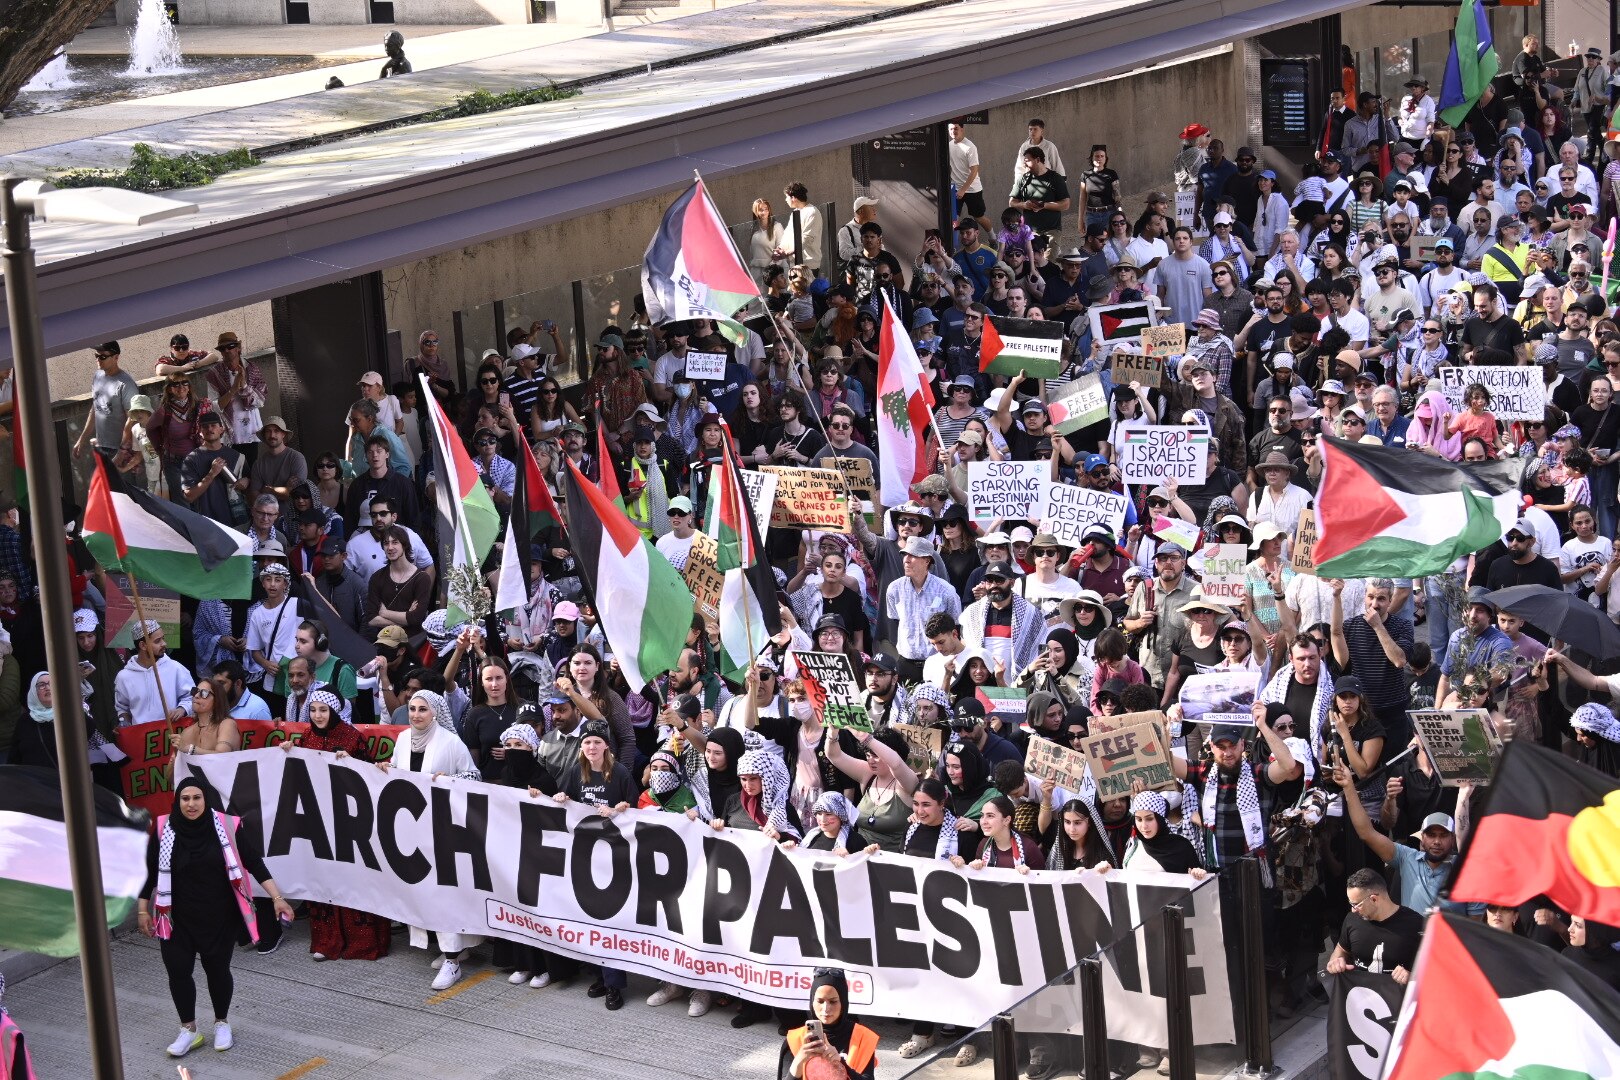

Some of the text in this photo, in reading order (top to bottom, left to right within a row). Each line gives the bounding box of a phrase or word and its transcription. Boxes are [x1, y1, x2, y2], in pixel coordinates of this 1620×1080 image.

[1005, 342, 1059, 354] FREE PALESTINE
[1146, 340, 1183, 356] NOW
[1467, 368, 1529, 388] SANCTION
[1066, 391, 1096, 411] FREE
[1147, 430, 1186, 448] STOP
[1132, 444, 1196, 462] ISRAEL'S
[778, 469, 807, 477] CANNOT
[810, 471, 834, 481] BUILD
[986, 462, 1024, 479] STOP
[1125, 462, 1197, 478] GENOCIDE
[789, 480, 808, 490] LAND
[827, 482, 844, 492] YOUR
[971, 477, 1040, 492] STARVING
[775, 489, 796, 499] EOPLE
[972, 492, 1039, 505] PALESTINIAN
[1049, 485, 1126, 514] CHILDREN
[773, 500, 842, 511] ASS GRAVES OF
[992, 502, 1031, 517] KIDS!
[1047, 502, 1114, 524] DESERVE
[771, 512, 845, 525] HE INDIGENOUS
[697, 536, 717, 556] STO
[689, 545, 717, 570] GENOC
[1203, 558, 1245, 575] SILENCE
[688, 561, 721, 594] FREE
[1201, 582, 1245, 598] VIOLENCE
[795, 654, 843, 669] KILLING
[798, 666, 850, 683] CHILDREN
[828, 682, 850, 696] NOT
[518, 703, 536, 715] NYC
[1416, 714, 1453, 722] FROM
[1419, 721, 1444, 729] THE
[1088, 731, 1139, 759] FREE
[1429, 741, 1453, 749] SEA
[1098, 761, 1174, 796] PALESTINE
[186, 756, 1207, 998] MARCH FOR PALESTINE
[495, 906, 553, 938] Justice
[557, 924, 585, 944] for
[590, 930, 670, 962] Palestine
